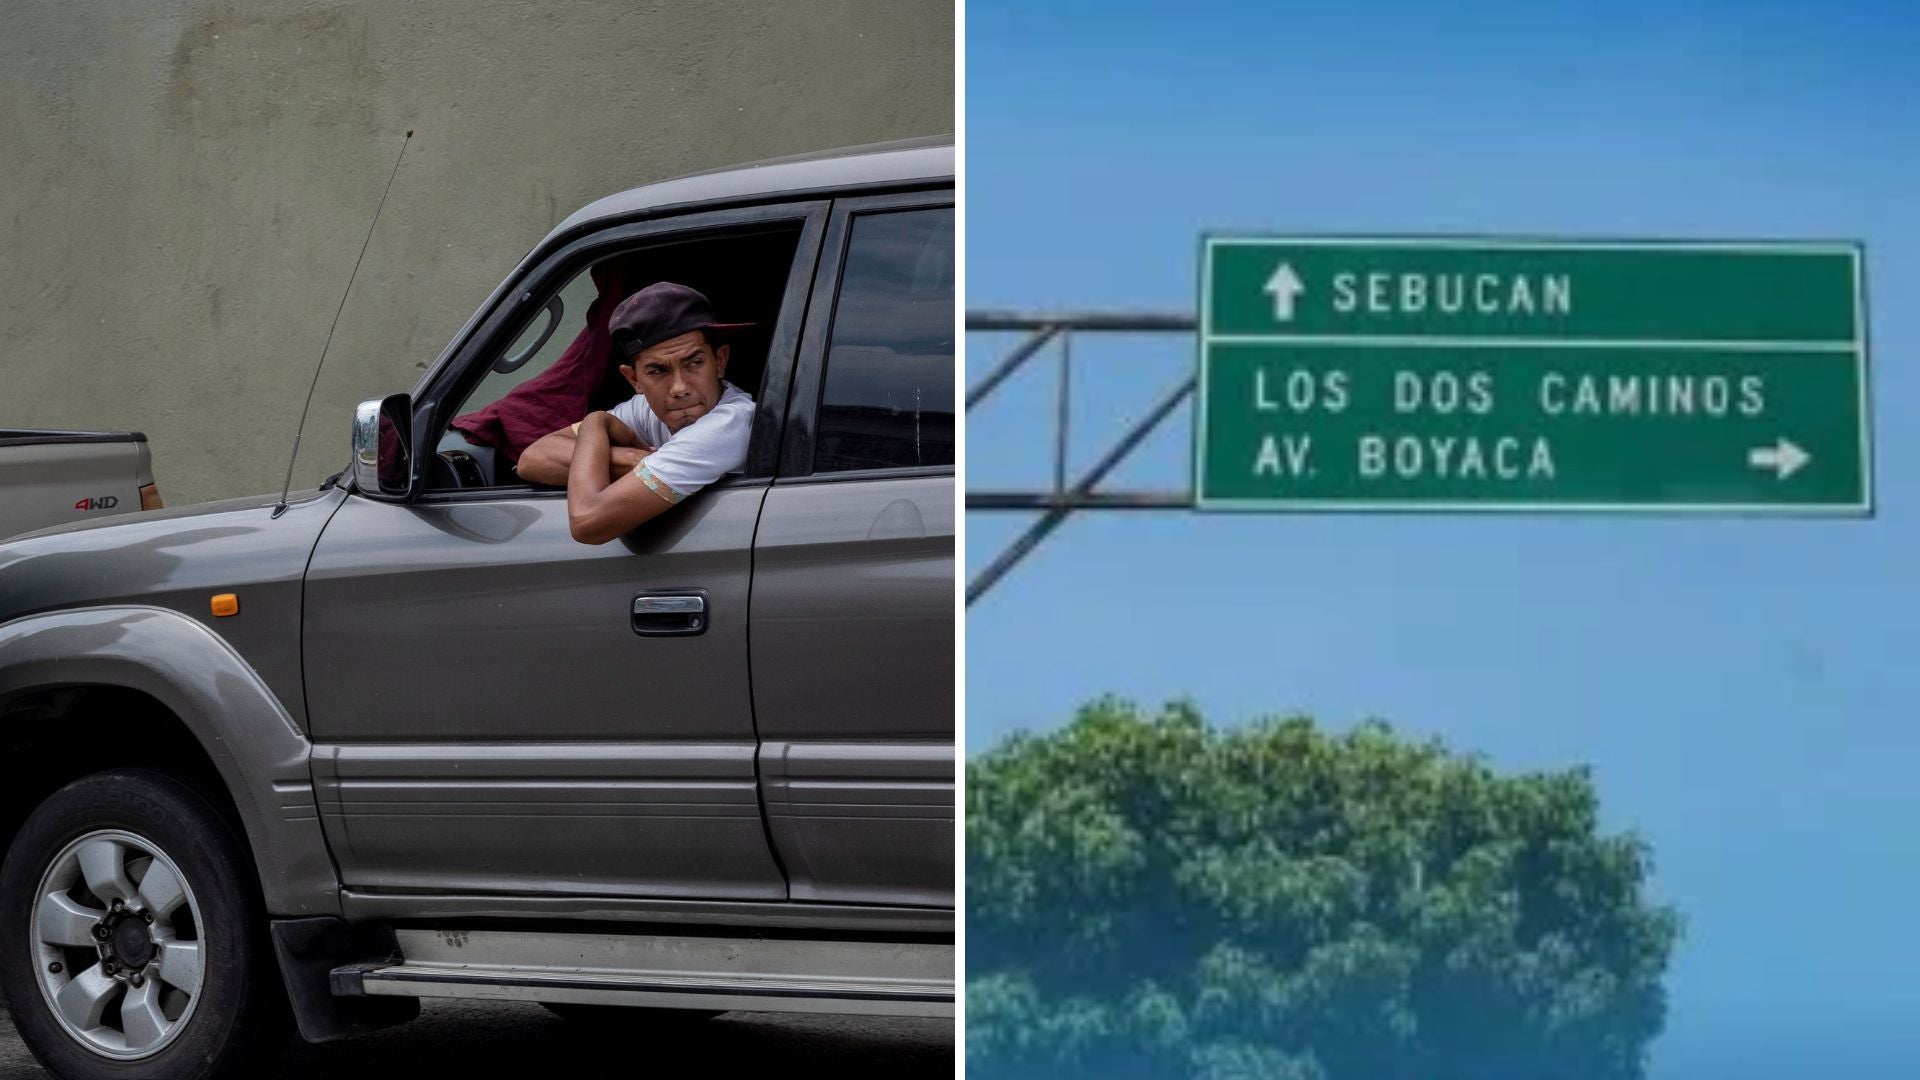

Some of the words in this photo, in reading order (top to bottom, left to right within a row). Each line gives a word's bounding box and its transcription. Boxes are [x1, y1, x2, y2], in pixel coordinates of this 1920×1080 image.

[1332, 273, 1571, 315] SEBUCAN
[1254, 370, 1350, 412] LOS
[1394, 372, 1493, 412] DOS
[1540, 374, 1766, 416] CAMINOS
[1253, 436, 1317, 477] AV.
[1358, 437, 1556, 478] BOYACA
[75, 496, 118, 511] 4WD
